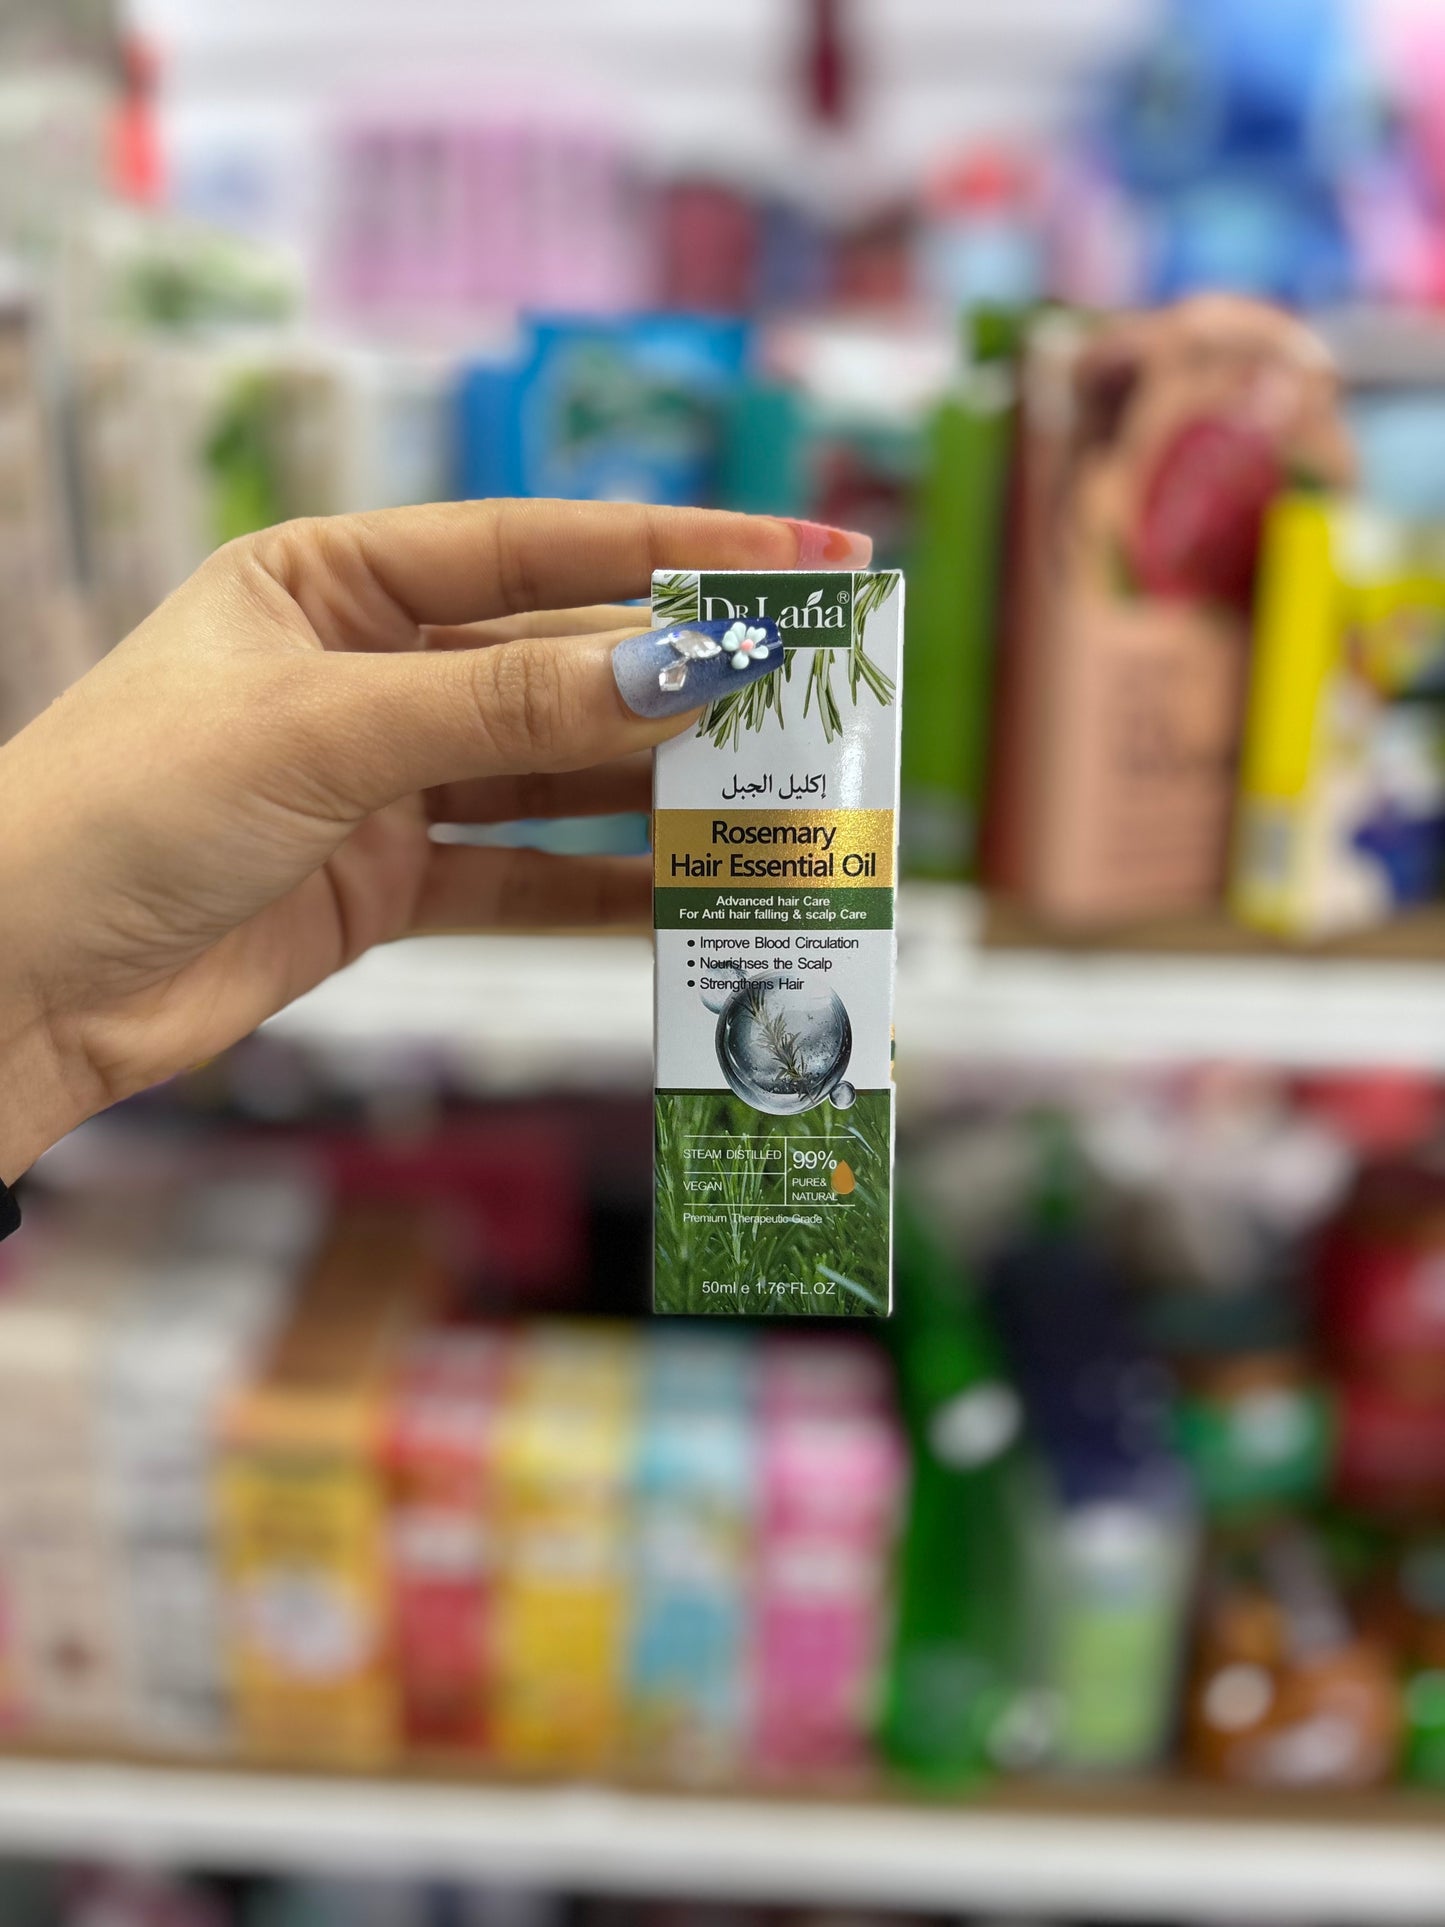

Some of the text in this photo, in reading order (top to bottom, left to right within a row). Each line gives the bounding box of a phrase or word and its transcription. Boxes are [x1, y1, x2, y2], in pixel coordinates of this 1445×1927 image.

[722, 773, 826, 800] إكليل الجبل
[712, 821, 836, 850] Rosemary
[671, 853, 876, 877] Hair Essential Oil
[716, 896, 830, 907] Advanced hair Care
[679, 909, 867, 922] For Anti hair falling & scalp Care
[700, 936, 859, 951] Improve Blood Circulation
[700, 957, 833, 973] Nourishses the Scalp
[700, 978, 805, 993] Strengthens Hair
[684, 1150, 782, 1160] STEAM DISTILLED
[792, 1151, 838, 1170] 99%
[684, 1181, 722, 1191] VEGAN
[792, 1178, 827, 1187] PURE&
[792, 1192, 838, 1201] NATURAL
[683, 1213, 823, 1225] Premium Therapeutic Grade
[702, 1281, 737, 1294] 50ml
[755, 1282, 785, 1295] 1.76
[791, 1282, 836, 1295] FL.OZ
